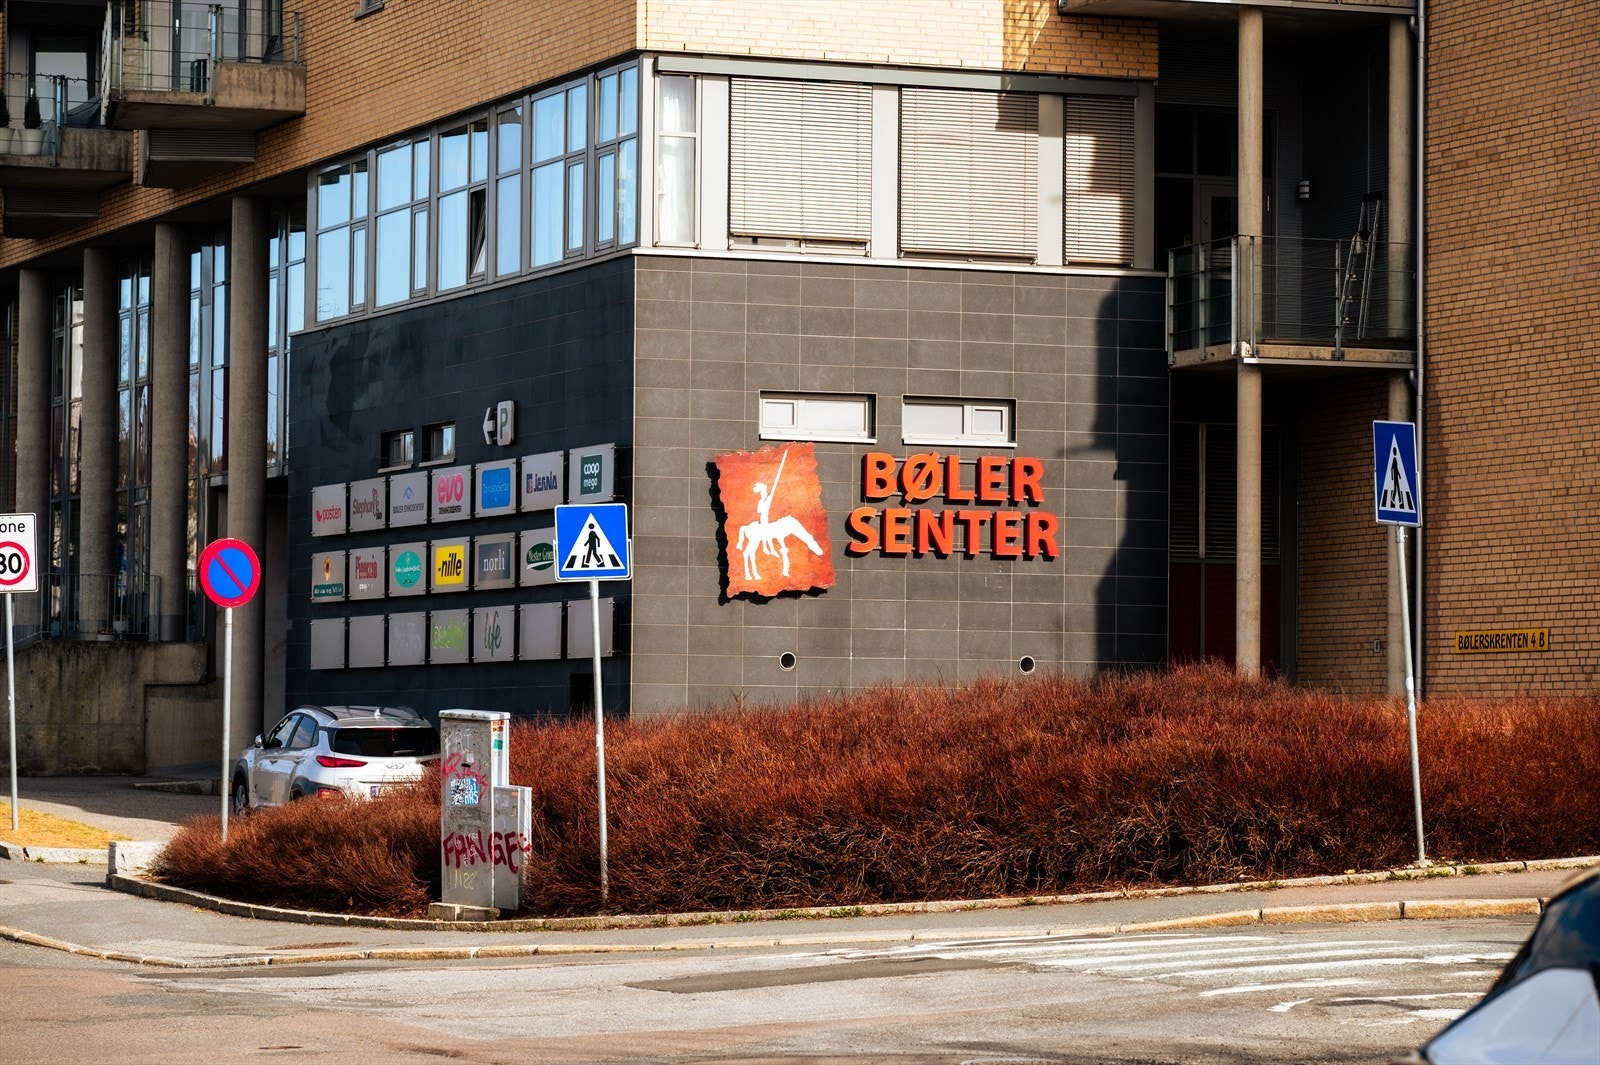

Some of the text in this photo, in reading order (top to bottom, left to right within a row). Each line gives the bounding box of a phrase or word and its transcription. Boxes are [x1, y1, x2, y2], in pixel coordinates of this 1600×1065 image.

[500, 407, 508, 440] P
[583, 462, 600, 476] coop
[864, 451, 1044, 503] BØLER
[437, 473, 465, 504] evo
[583, 477, 598, 490] mega
[322, 506, 342, 524] posten
[0, 522, 26, 534] one
[849, 507, 1060, 557] SENTER
[483, 548, 506, 572] norli
[484, 608, 502, 657] life
[1458, 631, 1545, 650] BØLERSKRENTEN 4 B
